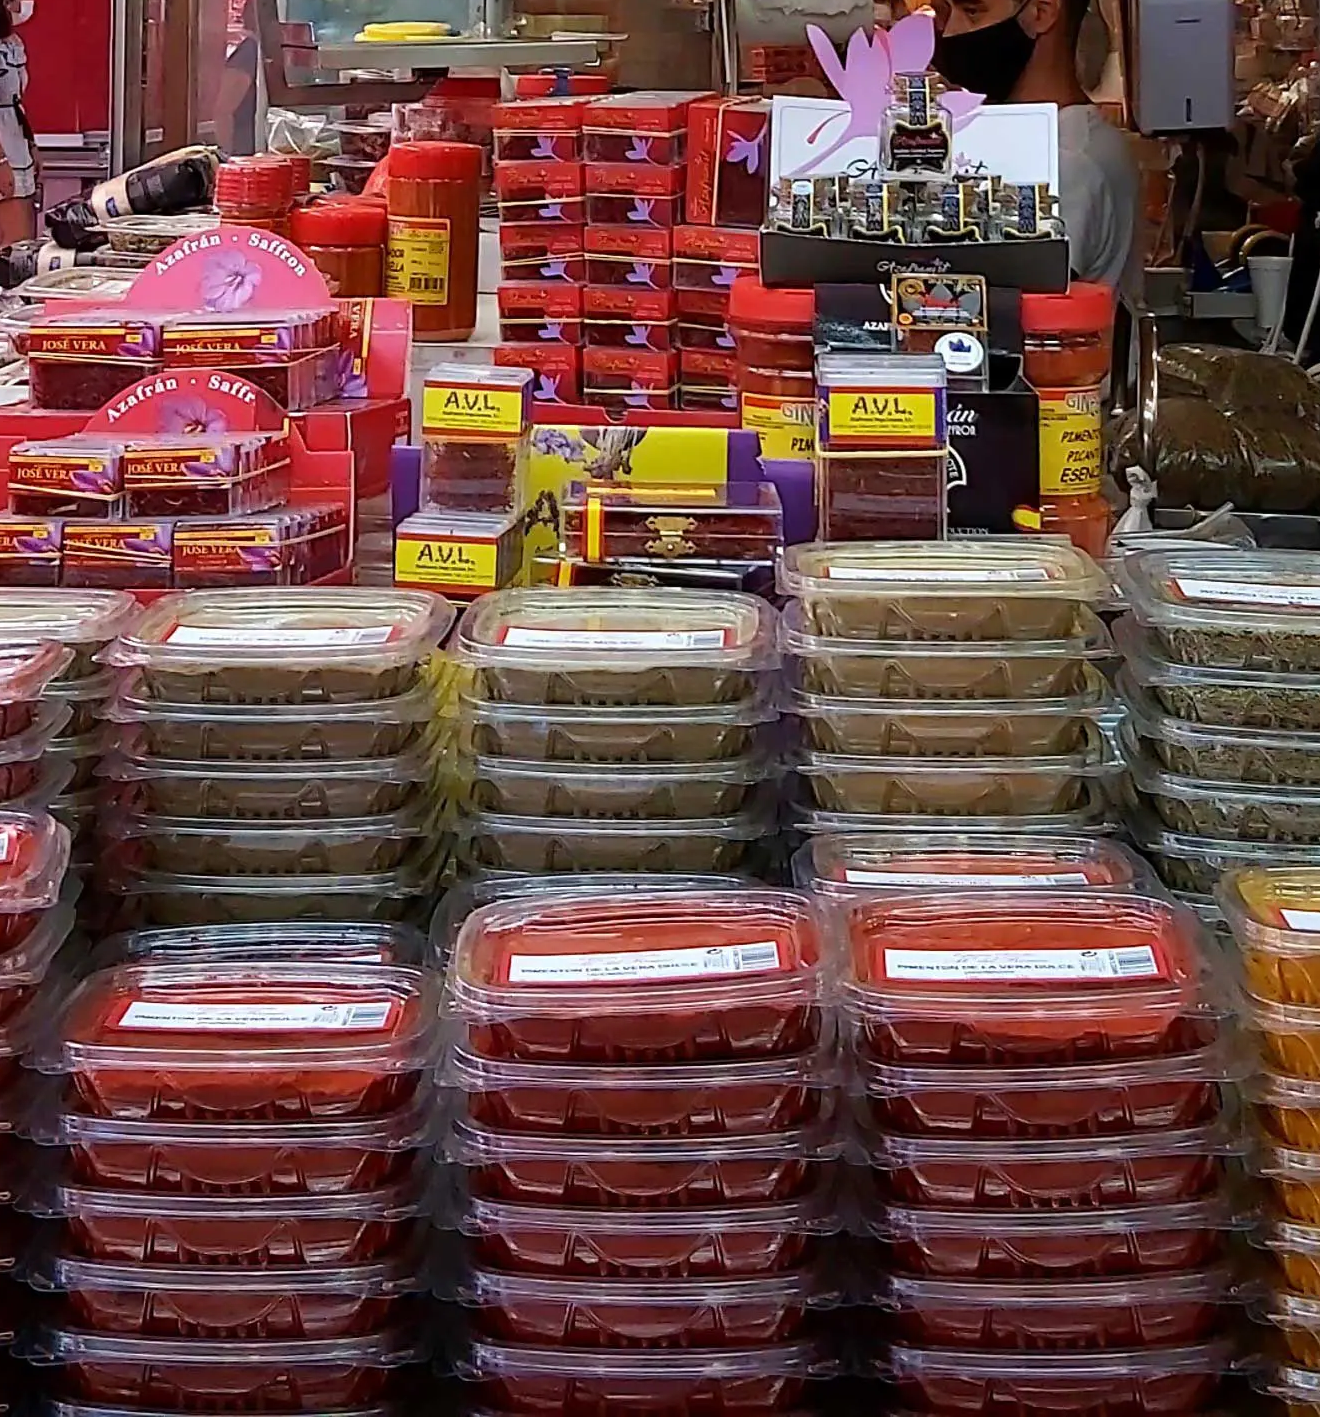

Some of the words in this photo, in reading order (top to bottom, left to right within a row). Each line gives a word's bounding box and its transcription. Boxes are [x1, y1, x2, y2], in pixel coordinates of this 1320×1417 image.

[154, 234, 222, 276] Azafrán
[247, 233, 306, 278] Saffron
[42, 337, 70, 351] JOSÉ
[72, 340, 106, 352] VERA
[107, 377, 178, 423] Azafrán
[208, 375, 256, 405] Saffr
[443, 390, 501, 412] A.V.L.
[852, 395, 913, 416] A.V.L.
[17, 466, 44, 480] JOSÉ
[128, 461, 155, 475] JOSÉ
[417, 543, 476, 565] A.V.L.
